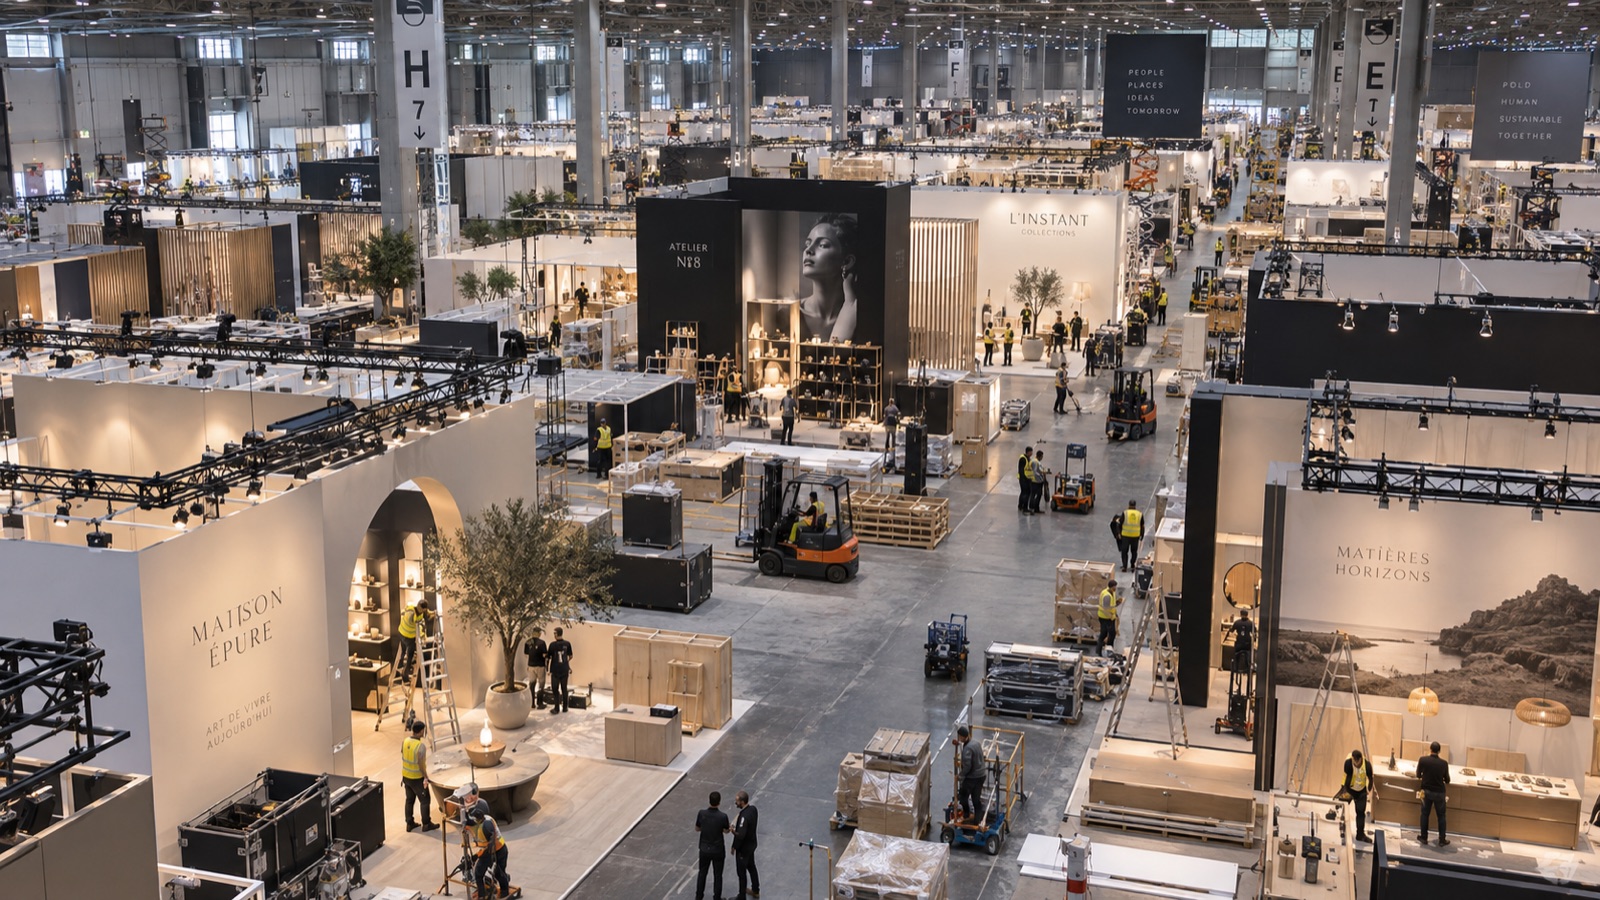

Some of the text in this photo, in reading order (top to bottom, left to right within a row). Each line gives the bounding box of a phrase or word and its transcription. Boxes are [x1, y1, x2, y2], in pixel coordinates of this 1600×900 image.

[404, 50, 430, 88] H
[951, 62, 959, 77] F
[1128, 69, 1165, 77] PEOPLE
[1334, 66, 1343, 83] E
[1366, 62, 1385, 90] E
[1127, 81, 1164, 89] PLACES
[1127, 94, 1155, 102] IDEAS
[1501, 98, 1538, 106] HUMAN
[412, 100, 425, 120] 7
[1127, 107, 1180, 115] TOMORROW
[1499, 115, 1562, 124] SUSTAINABLE
[1498, 132, 1552, 140] TOGETHER
[1010, 212, 1089, 227] L'INSTANT
[1021, 228, 1076, 237] COLLECTIONS
[669, 242, 708, 252] ATELIER
[1335, 563, 1431, 583] HORIZONS
[209, 620, 273, 668] ÉPURE
[206, 691, 271, 737] ART DE VIVRE
